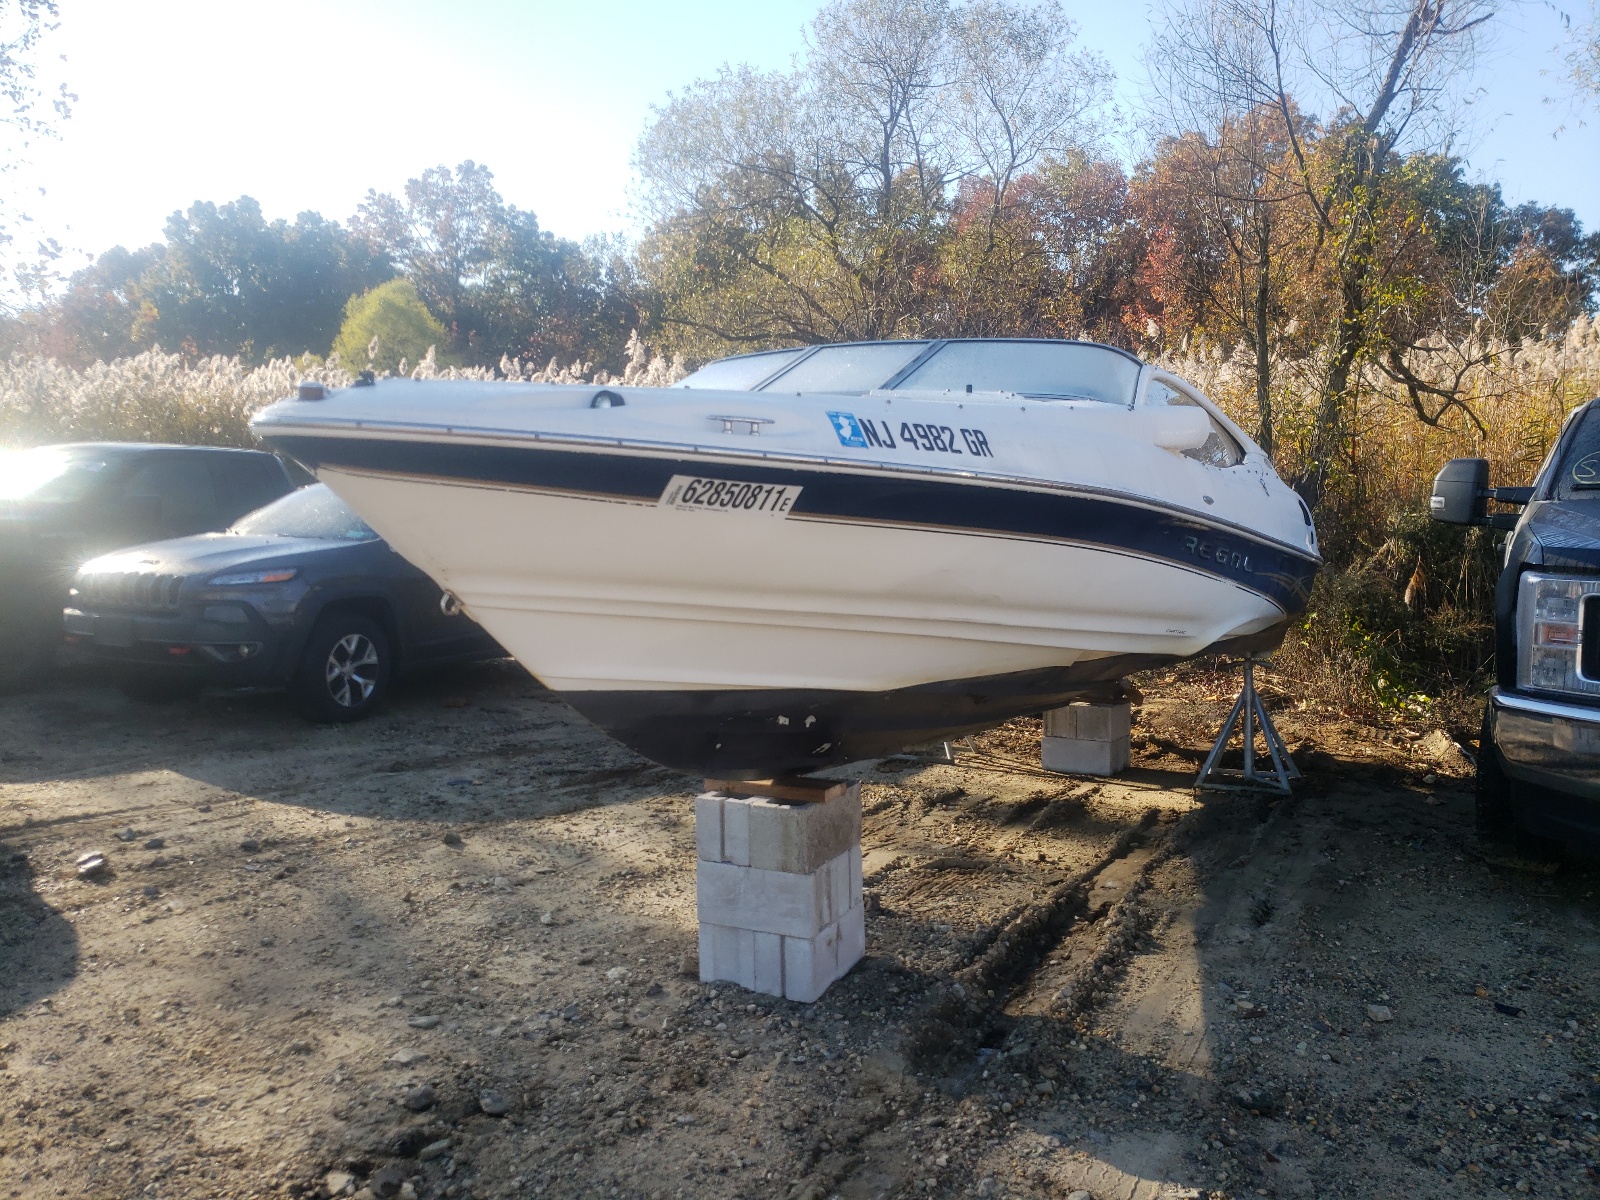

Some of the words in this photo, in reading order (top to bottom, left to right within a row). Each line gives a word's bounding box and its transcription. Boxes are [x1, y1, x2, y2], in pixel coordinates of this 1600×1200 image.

[858, 418, 896, 449] NJ
[900, 422, 962, 454] 4982
[960, 428, 994, 458] GR
